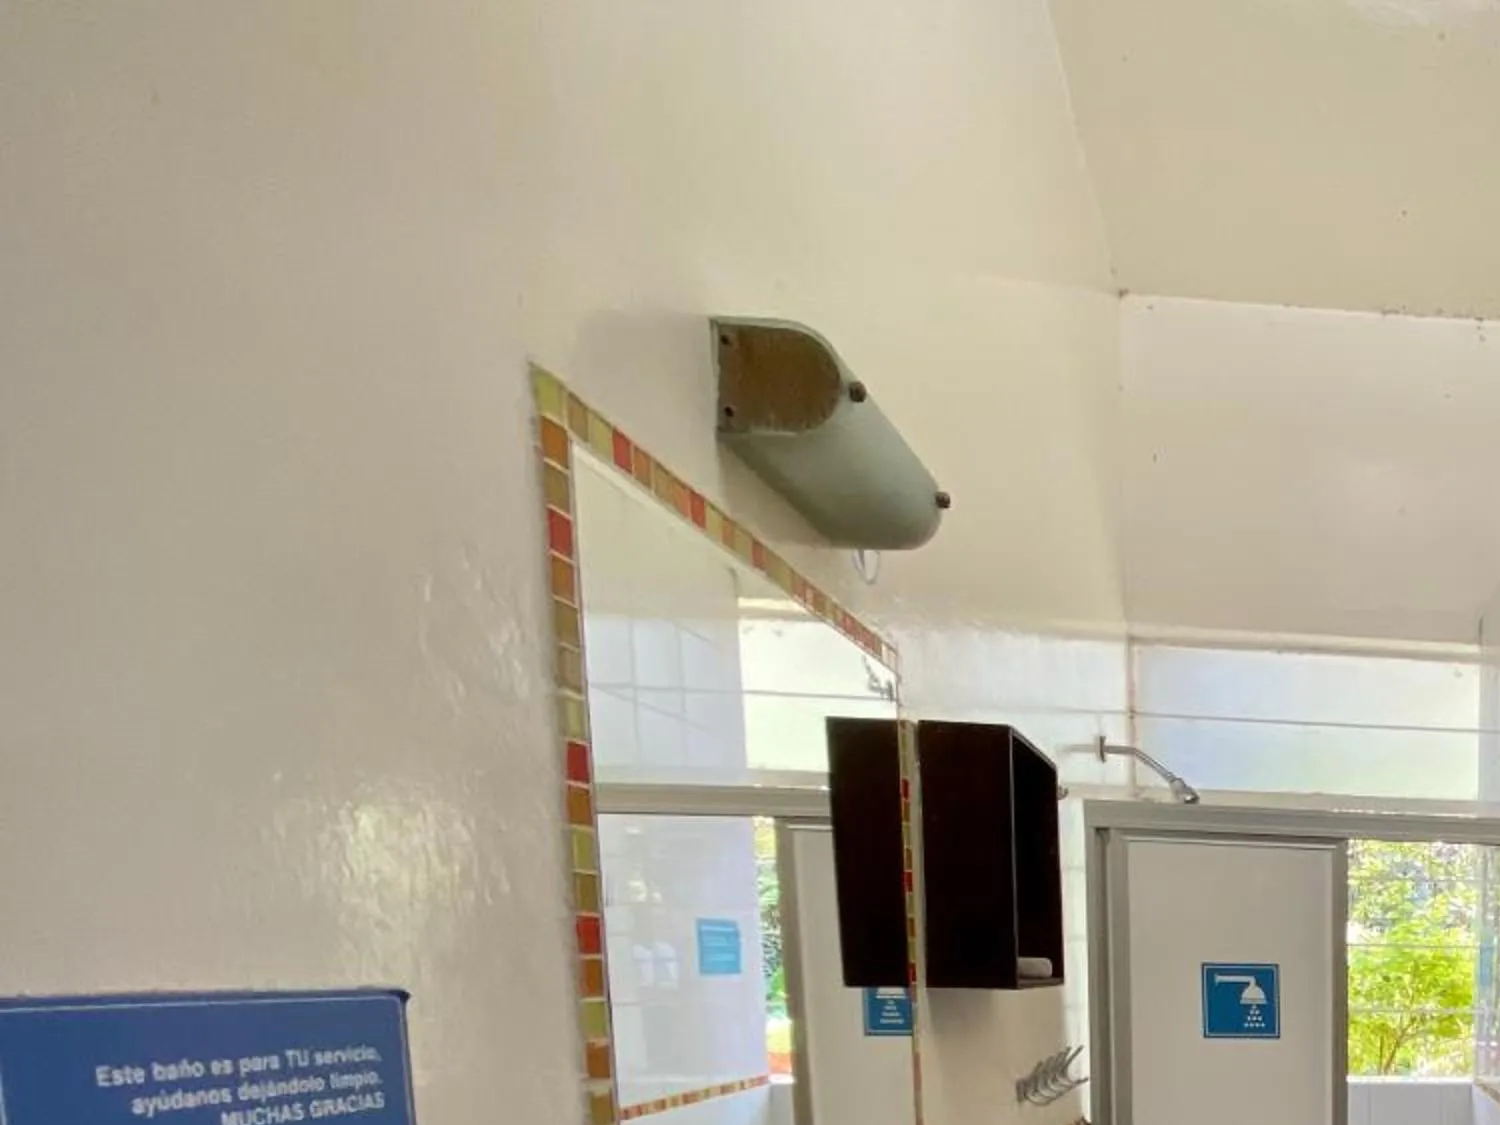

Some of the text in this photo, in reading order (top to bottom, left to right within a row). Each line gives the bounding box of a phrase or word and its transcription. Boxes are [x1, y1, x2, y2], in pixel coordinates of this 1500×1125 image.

[95, 1065, 145, 1086] Este
[153, 1059, 204, 1081] baño
[211, 1059, 233, 1076] es
[239, 1054, 280, 1077] para
[284, 1049, 310, 1067] TU
[131, 1086, 232, 1118] ayúdanos
[237, 1075, 325, 1103] dejándolo
[309, 1092, 385, 1119] GRACIAS
